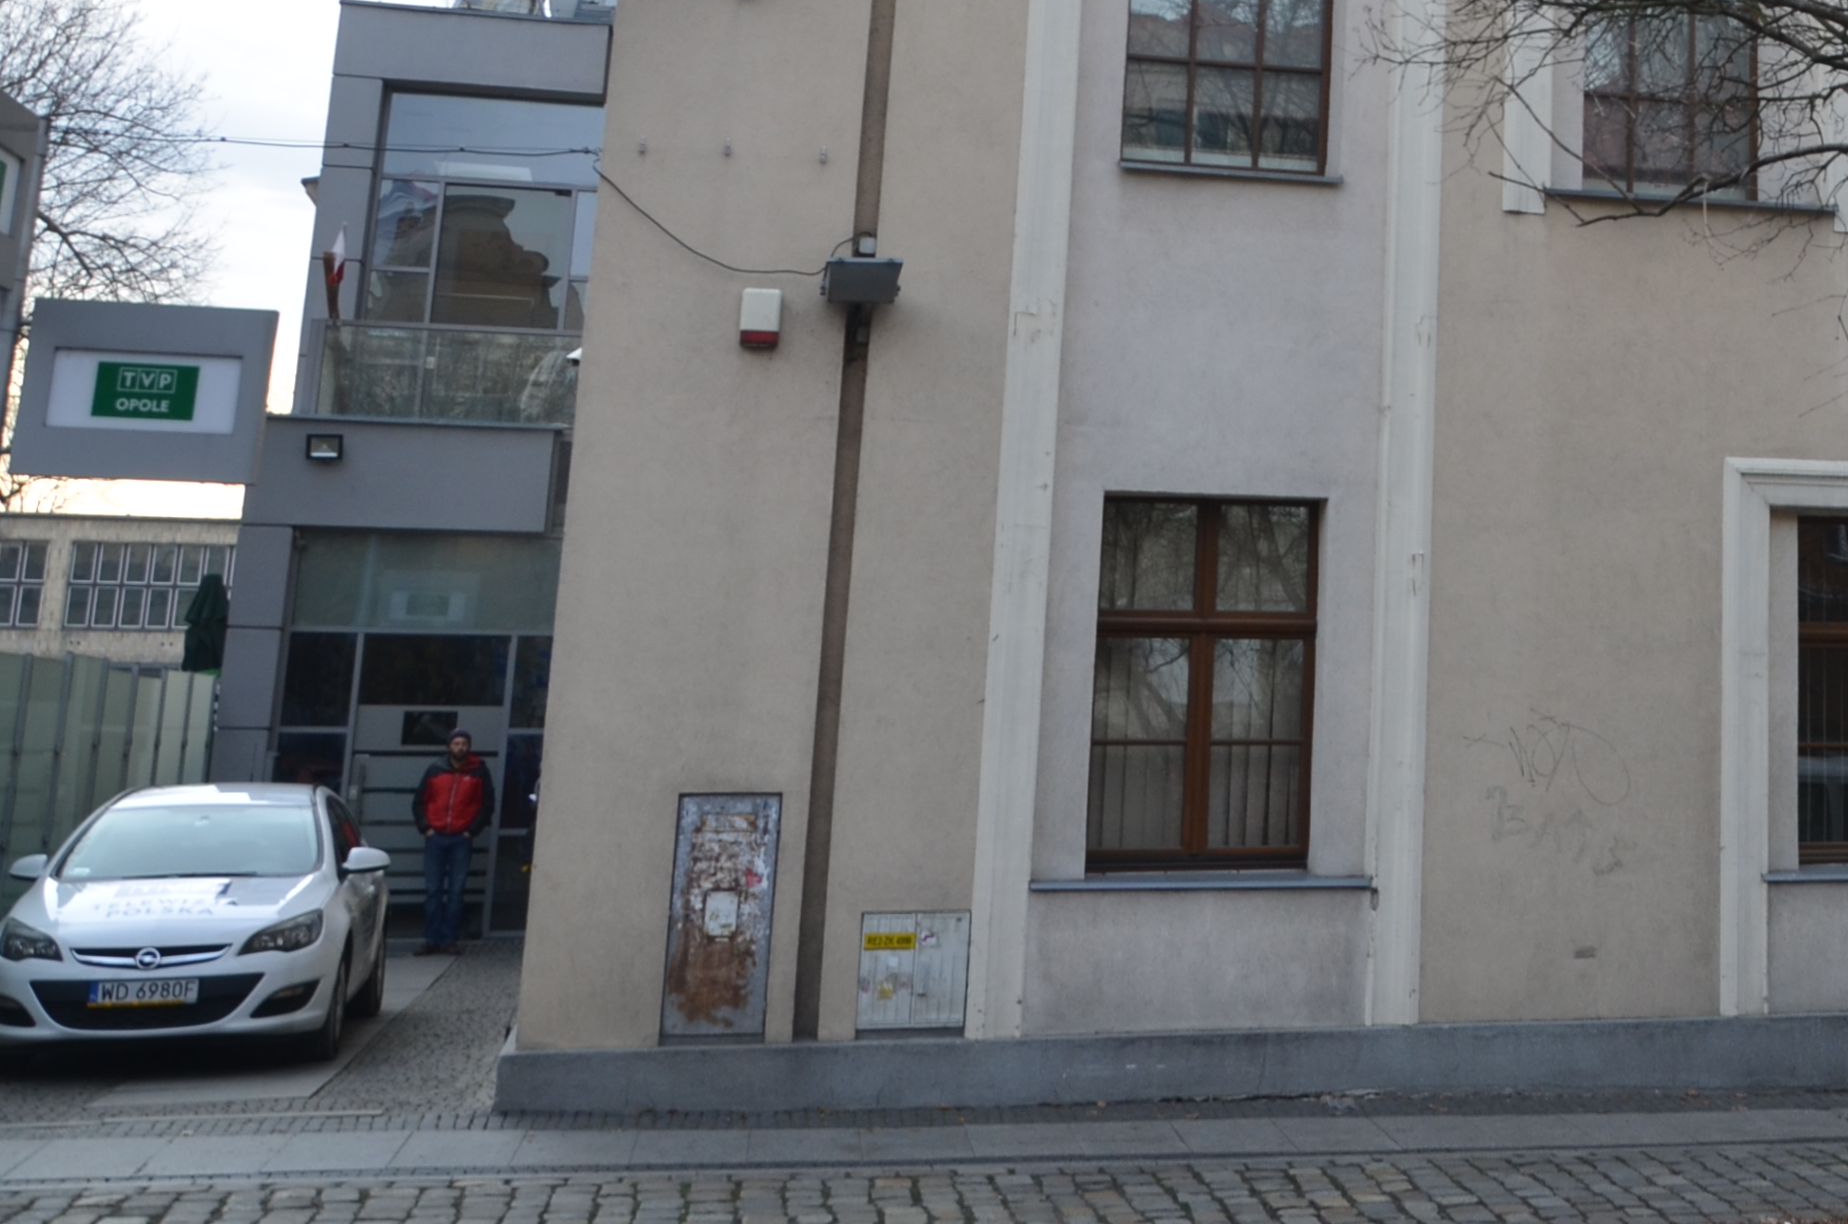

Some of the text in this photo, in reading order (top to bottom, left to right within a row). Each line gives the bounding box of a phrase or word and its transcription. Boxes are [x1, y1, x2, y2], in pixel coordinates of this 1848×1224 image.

[121, 370, 173, 389] TVP
[115, 397, 170, 413] OPOLE
[106, 905, 214, 919] POLSKA
[101, 982, 129, 1002] WD
[136, 979, 197, 1000] 6980F
